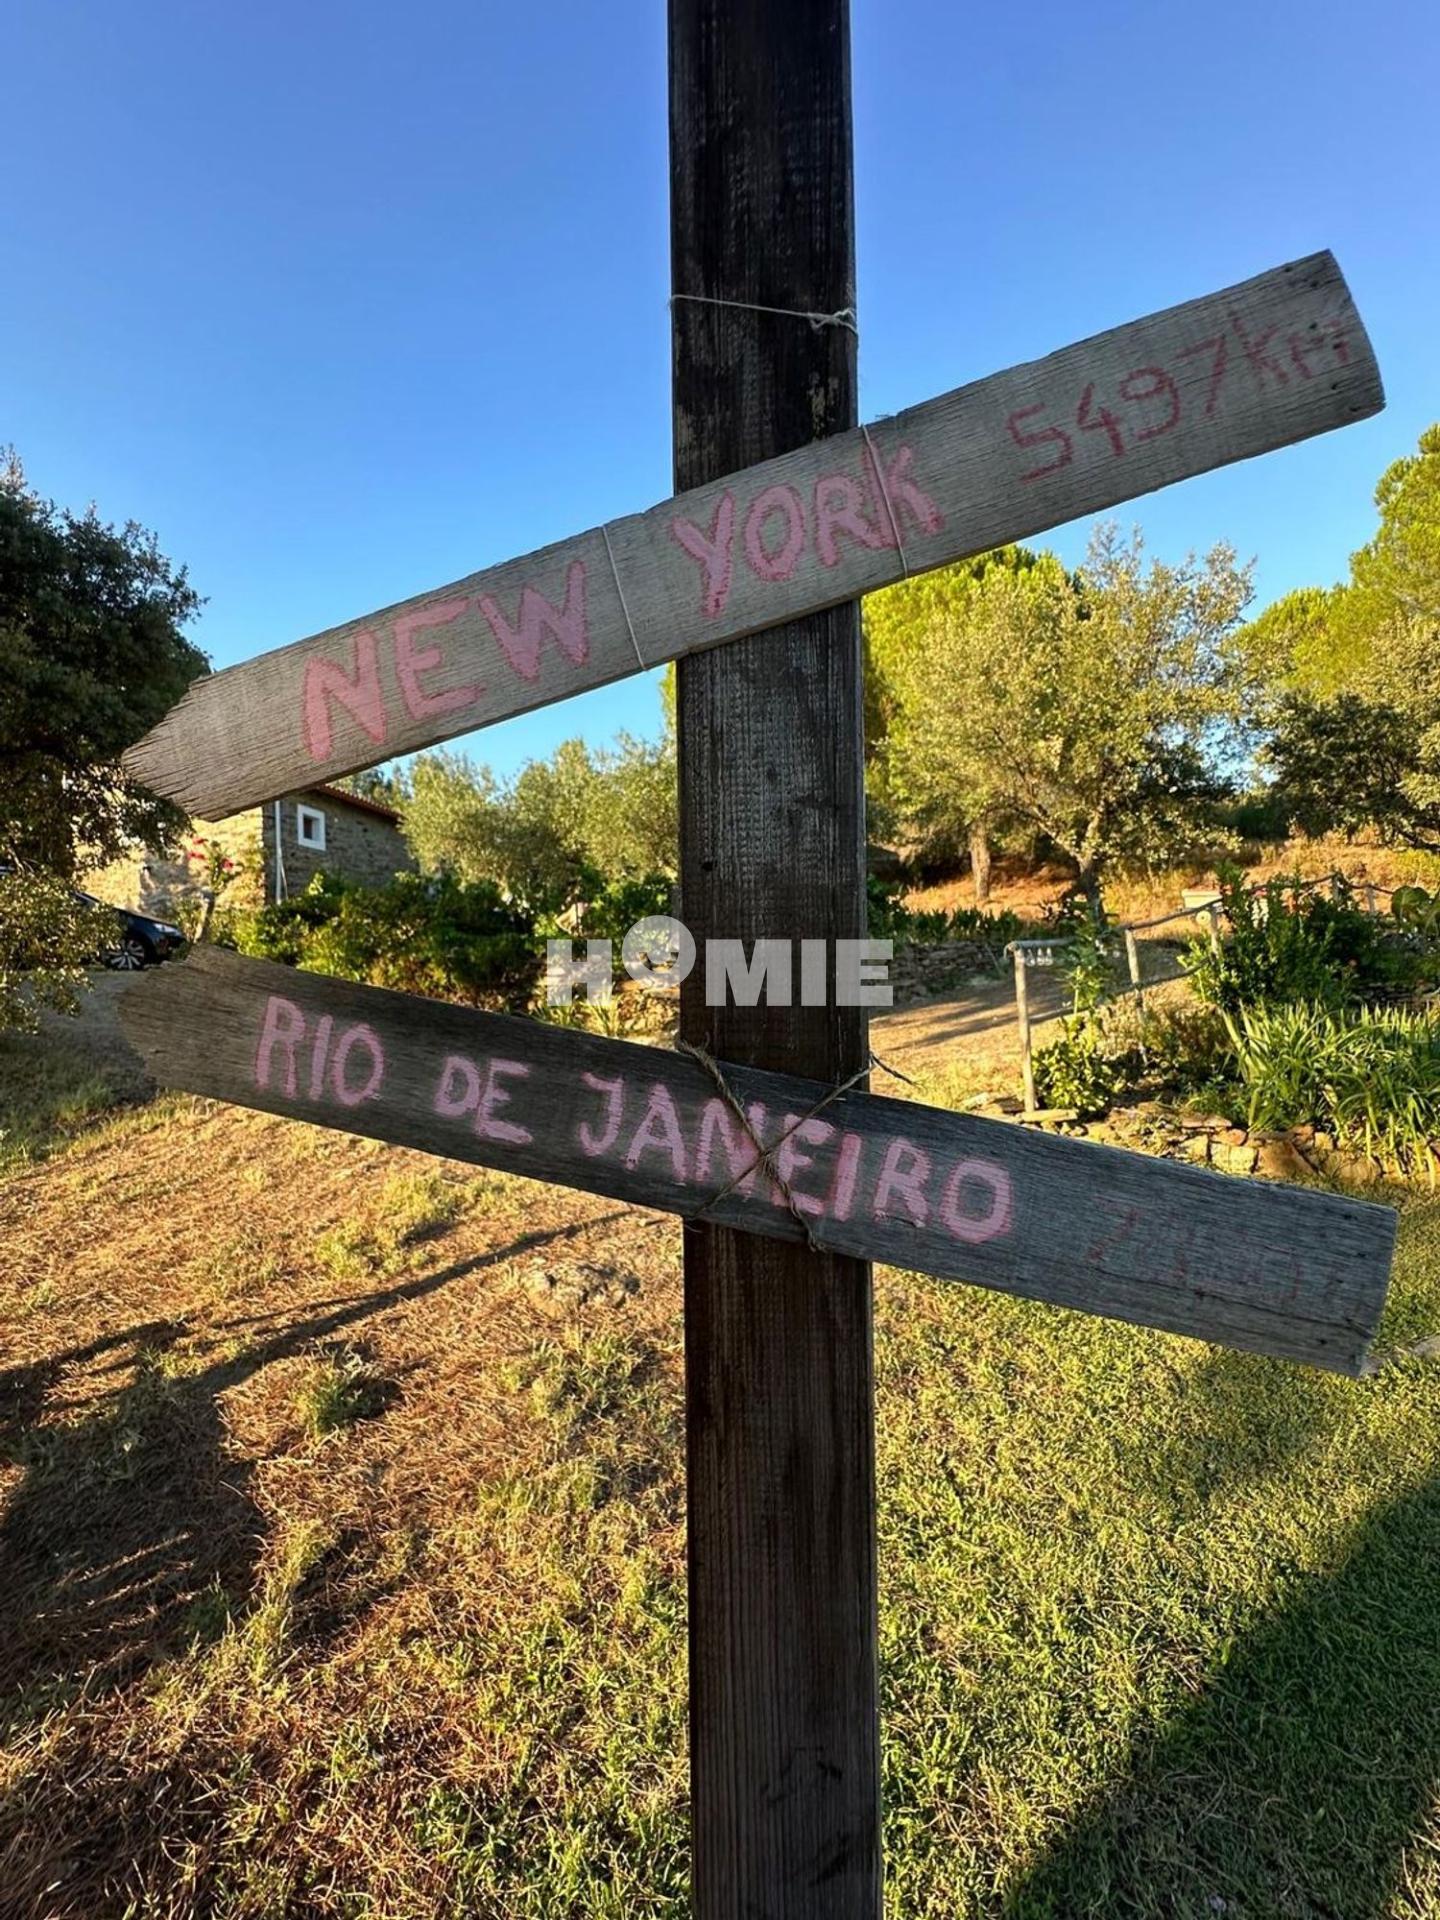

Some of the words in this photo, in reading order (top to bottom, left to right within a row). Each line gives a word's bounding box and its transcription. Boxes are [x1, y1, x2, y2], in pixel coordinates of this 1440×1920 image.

[303, 560, 589, 763] NEW
[671, 437, 945, 619] YORK
[255, 996, 386, 1105] RIO
[434, 1055, 533, 1145] DE
[579, 1071, 1016, 1243] JANEIRO
